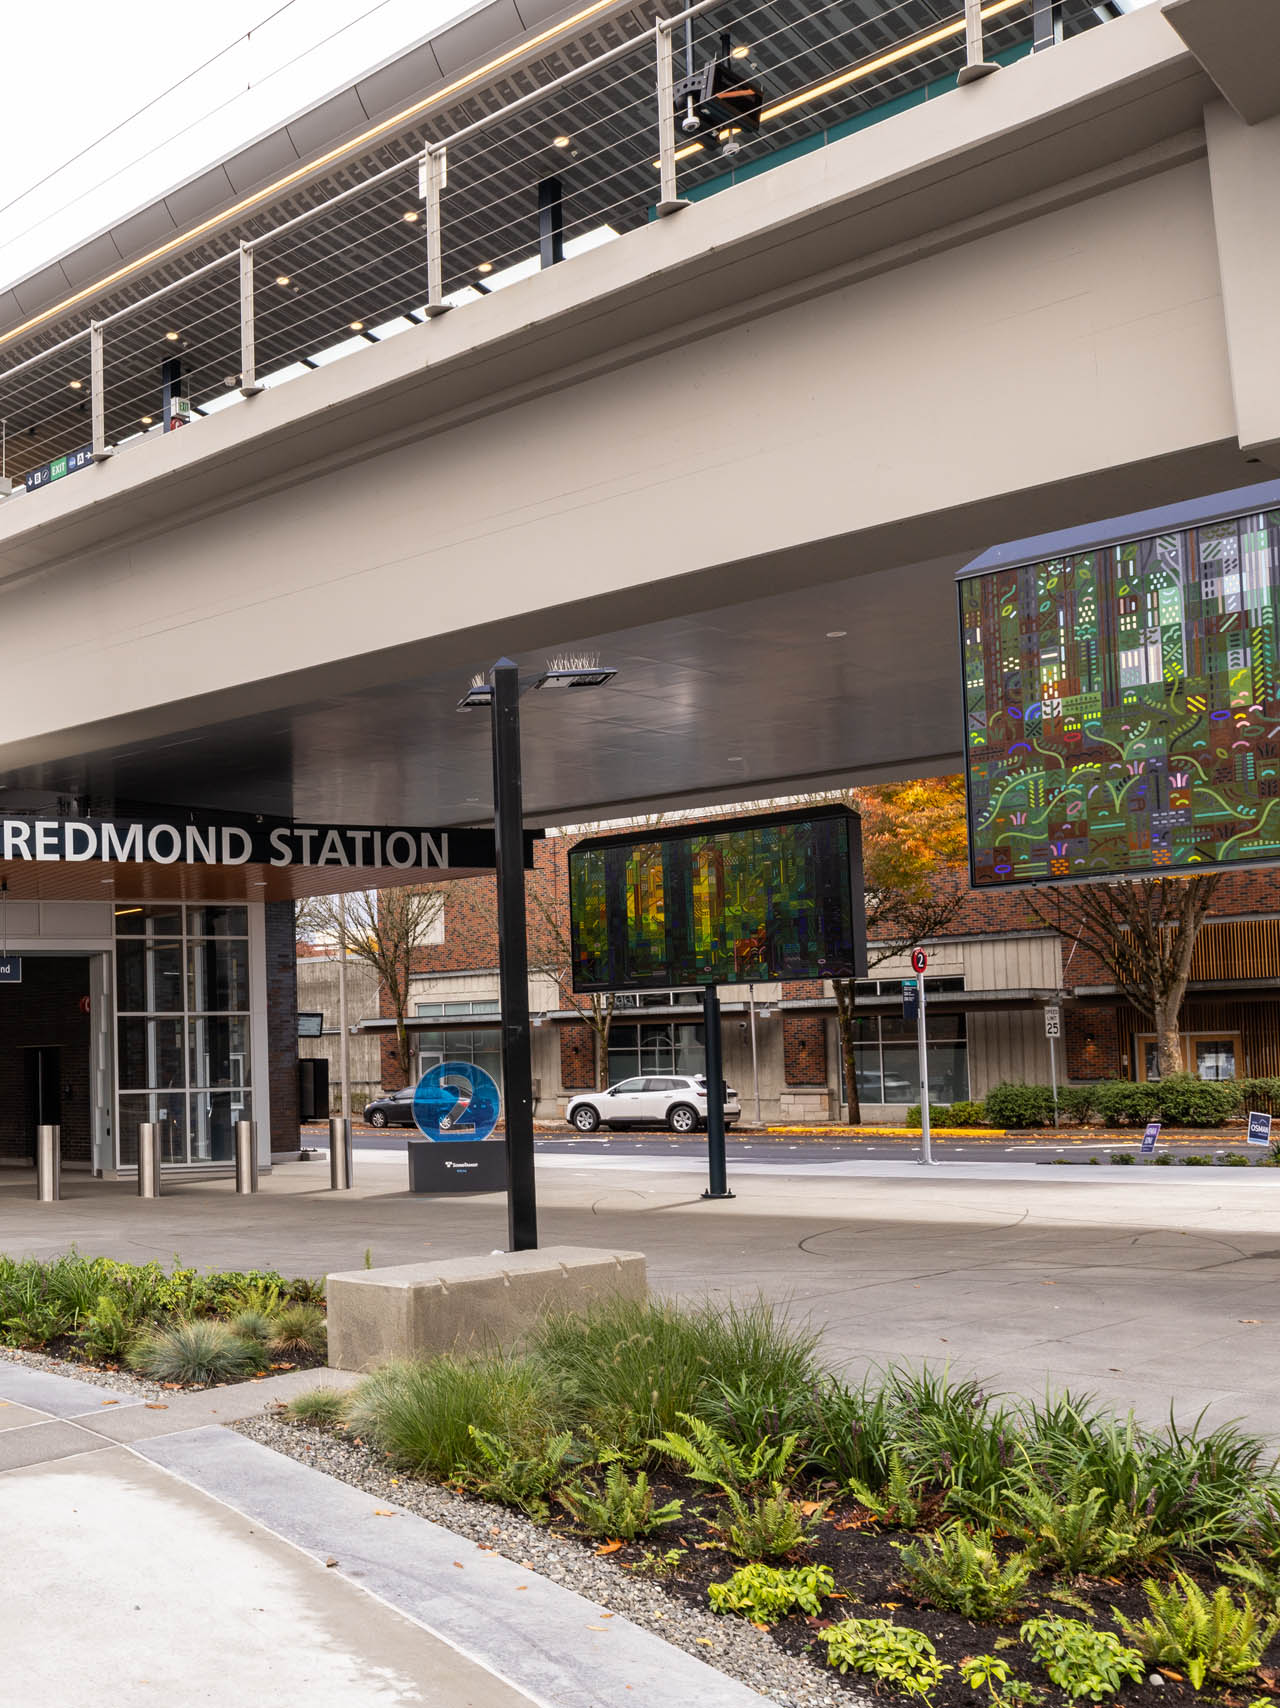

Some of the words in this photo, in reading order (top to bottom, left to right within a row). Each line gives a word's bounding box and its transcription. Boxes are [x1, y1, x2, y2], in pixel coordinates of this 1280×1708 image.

[51, 462, 65, 476] EXIT
[4, 819, 253, 865] REDMOND
[269, 827, 449, 869] STATION
[917, 953, 924, 968] 2
[1047, 1023, 1058, 1034] 25
[439, 1074, 476, 1134] 2
